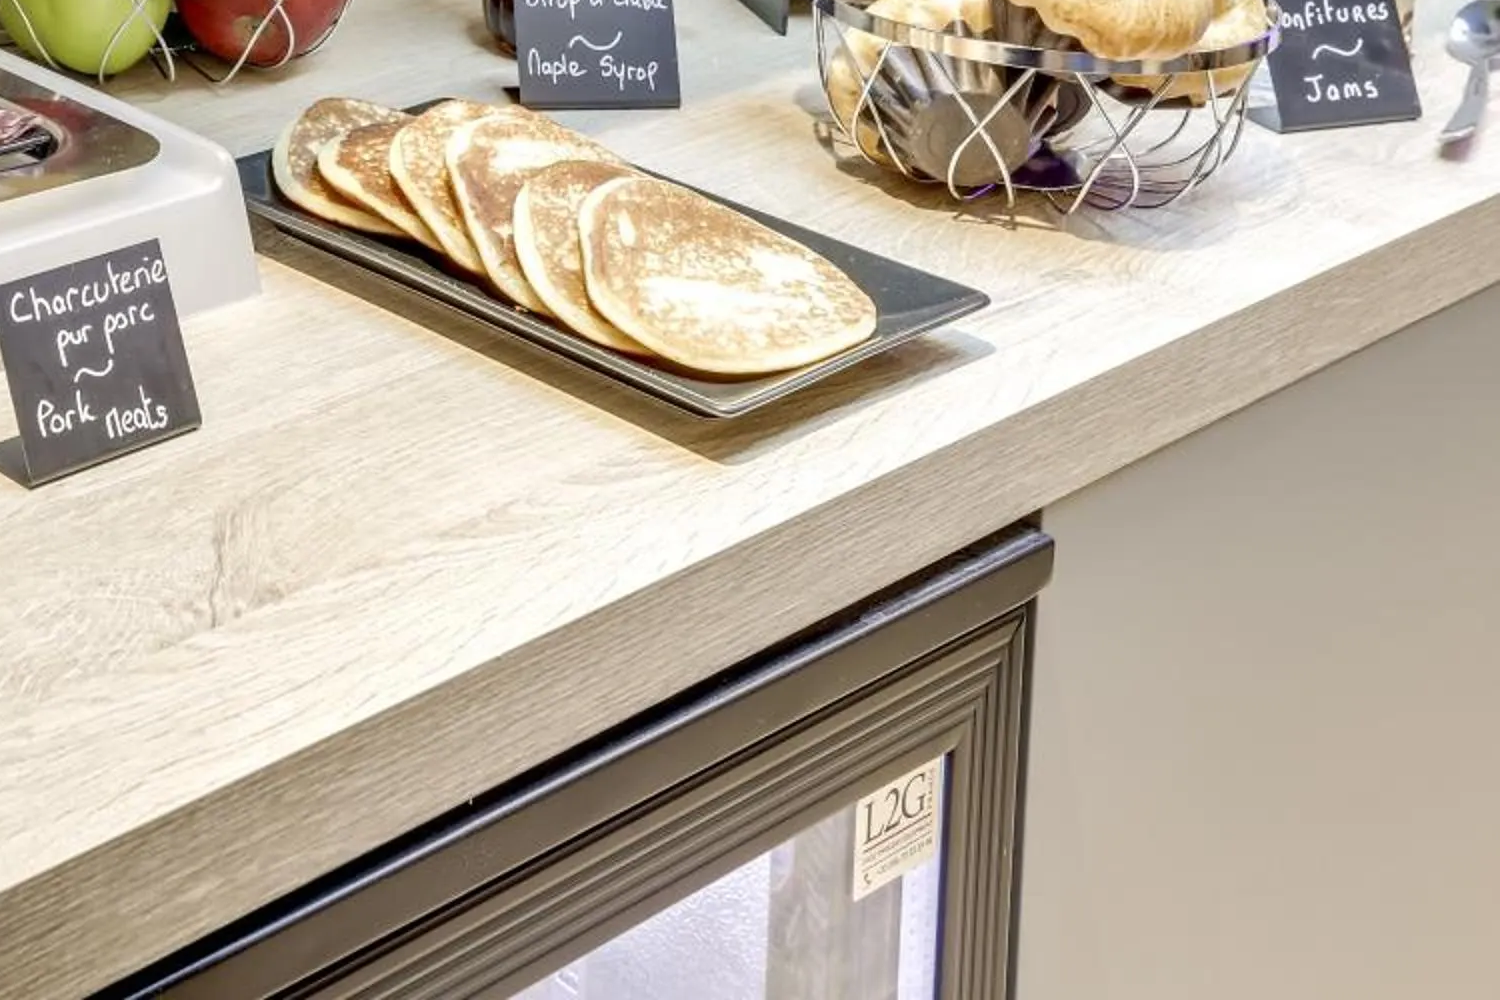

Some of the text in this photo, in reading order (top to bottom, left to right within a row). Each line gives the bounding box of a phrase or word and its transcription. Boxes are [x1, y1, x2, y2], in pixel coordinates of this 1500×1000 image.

[600, 55, 660, 92] Syrop
[1303, 73, 1379, 102] Jams
[10, 256, 168, 323] Charcuterie
[57, 303, 155, 368] pur porc
[37, 389, 98, 439] Pork
[864, 771, 927, 845] L2G
